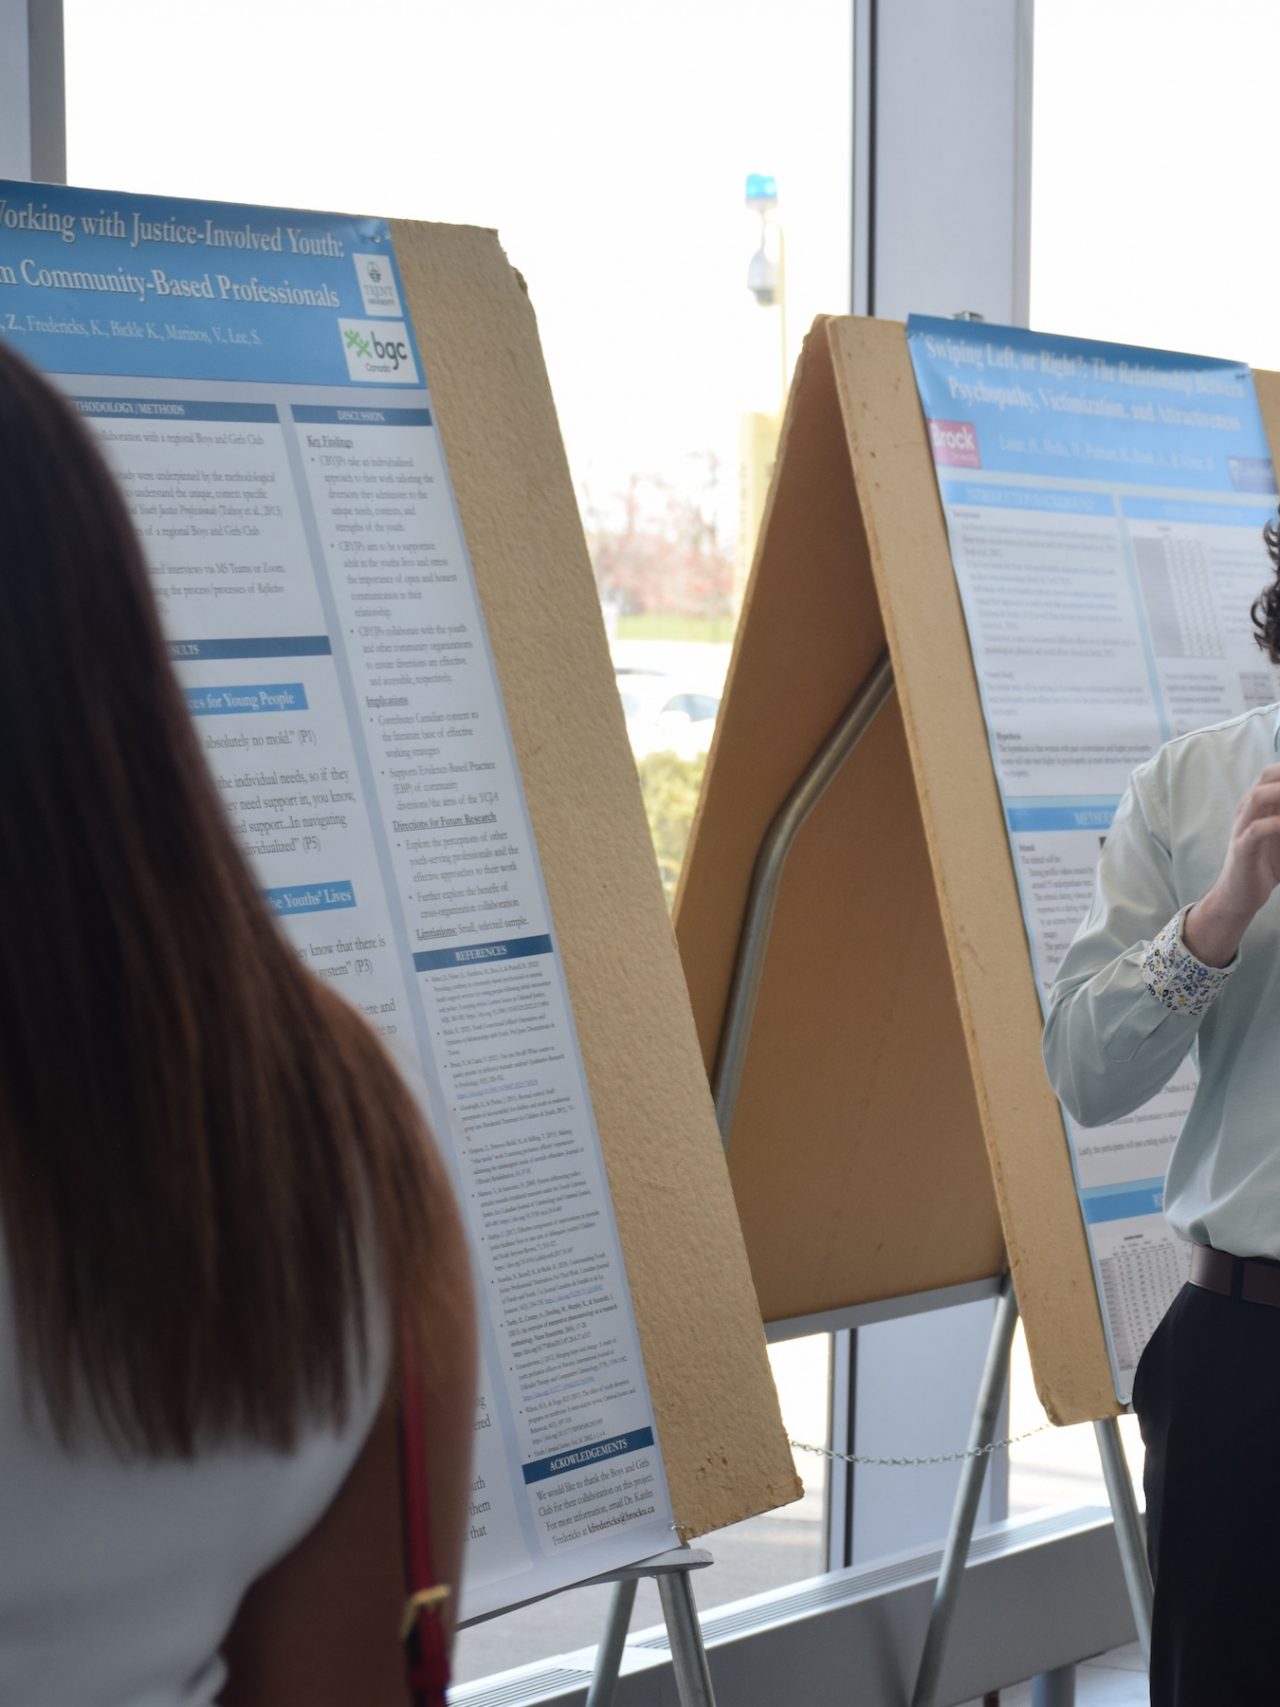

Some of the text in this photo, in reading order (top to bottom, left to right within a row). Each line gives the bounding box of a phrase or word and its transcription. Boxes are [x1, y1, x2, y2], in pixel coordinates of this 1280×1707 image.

[81, 209, 128, 238] with
[130, 212, 283, 253] Justice-Involved
[286, 227, 345, 259] Youth:
[21, 258, 214, 303] Community-Based
[217, 276, 341, 309] Professionals
[370, 330, 408, 370] bgc
[926, 335, 984, 372] Swiping
[1021, 352, 1037, 370] or
[336, 410, 385, 422] DISCUSSION
[1131, 400, 1155, 421] and
[931, 422, 976, 450] Brock
[207, 693, 222, 708] for
[222, 692, 259, 711] Young
[260, 690, 294, 709] People
[253, 735, 264, 745] no
[234, 772, 278, 788] individual
[240, 795, 262, 811] need
[263, 795, 298, 812] support
[313, 794, 329, 807] you
[302, 814, 347, 830] navigating
[464, 812, 497, 825] Research
[324, 888, 352, 904] Lives
[310, 942, 335, 956] know
[336, 938, 354, 952] that
[354, 936, 377, 951] there
[378, 934, 387, 947] is
[454, 945, 507, 961] REFERENCES
[380, 997, 396, 1013] and
[549, 1439, 629, 1472] ACKOWLEDGEMENTS
[577, 1487, 614, 1505] collaboration
[469, 1525, 487, 1541] that
